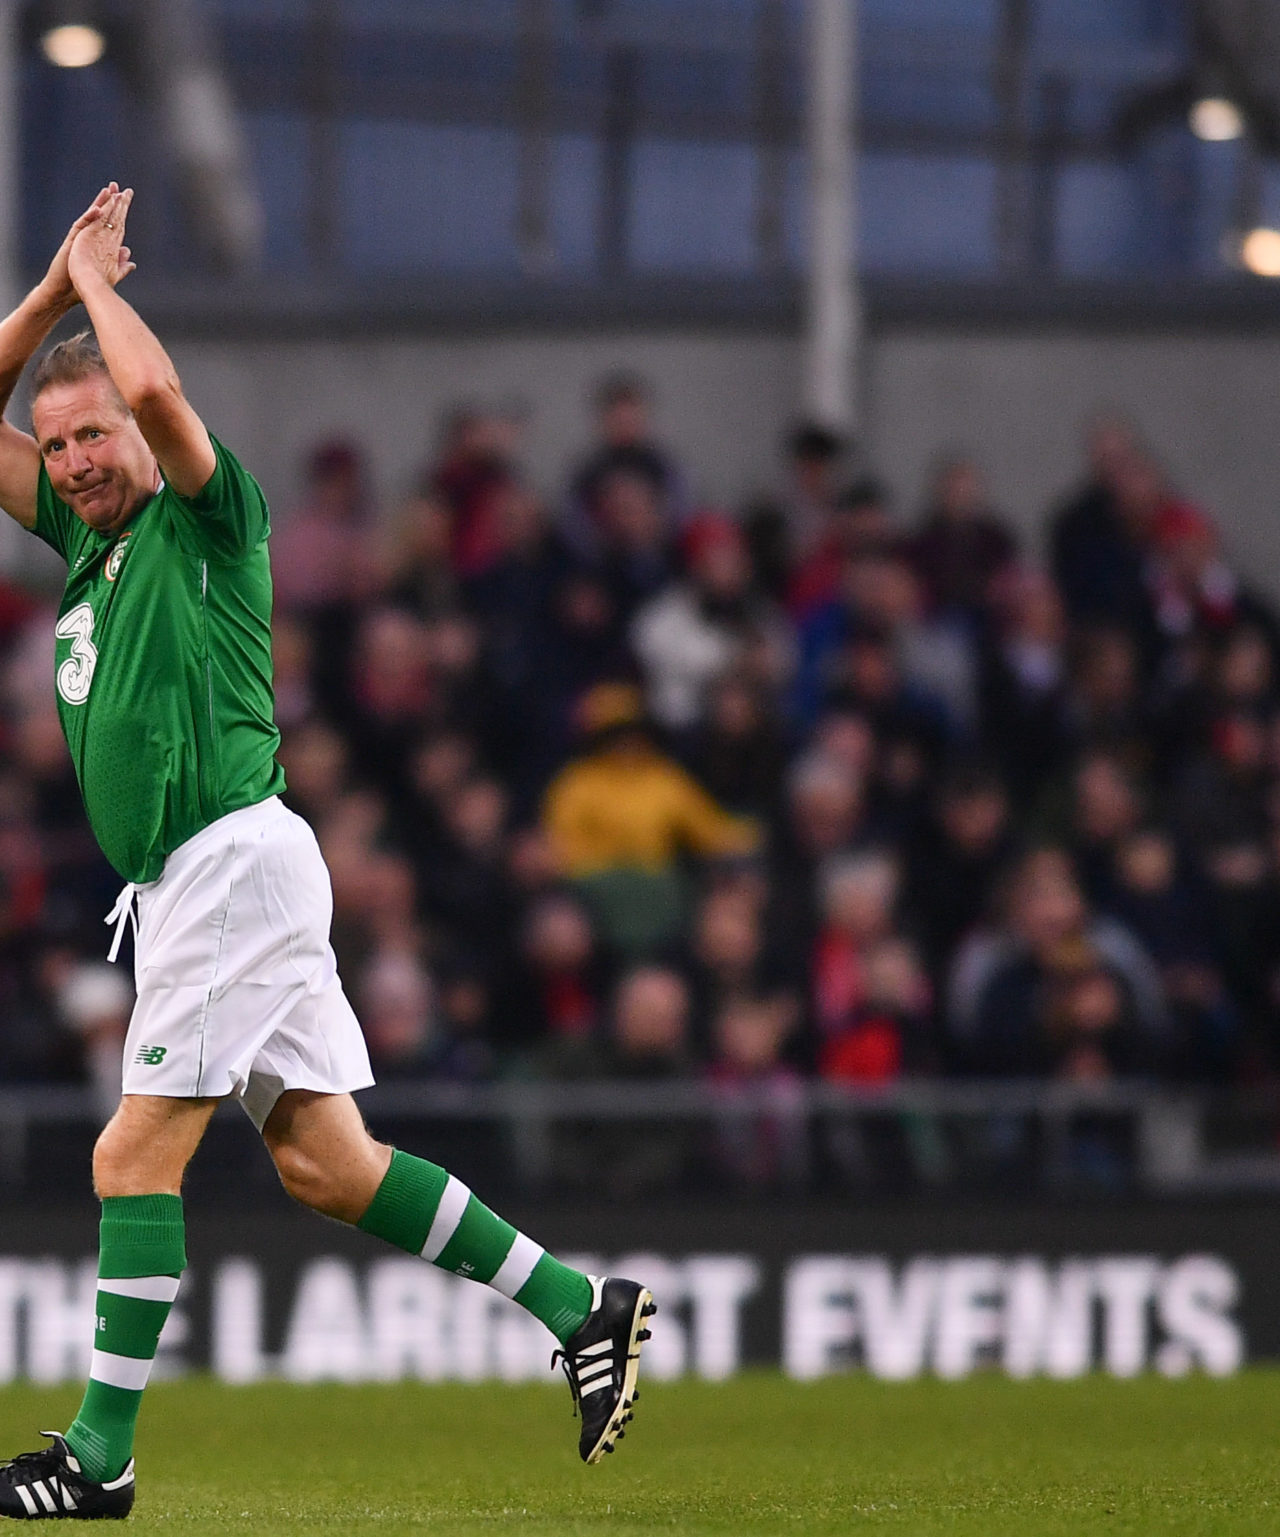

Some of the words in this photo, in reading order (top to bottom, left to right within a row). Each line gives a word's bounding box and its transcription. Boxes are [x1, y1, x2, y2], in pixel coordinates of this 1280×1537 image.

[55, 602, 99, 706] 3
[210, 1256, 757, 1384] LARGST
[782, 1255, 1244, 1380] EVENTS
